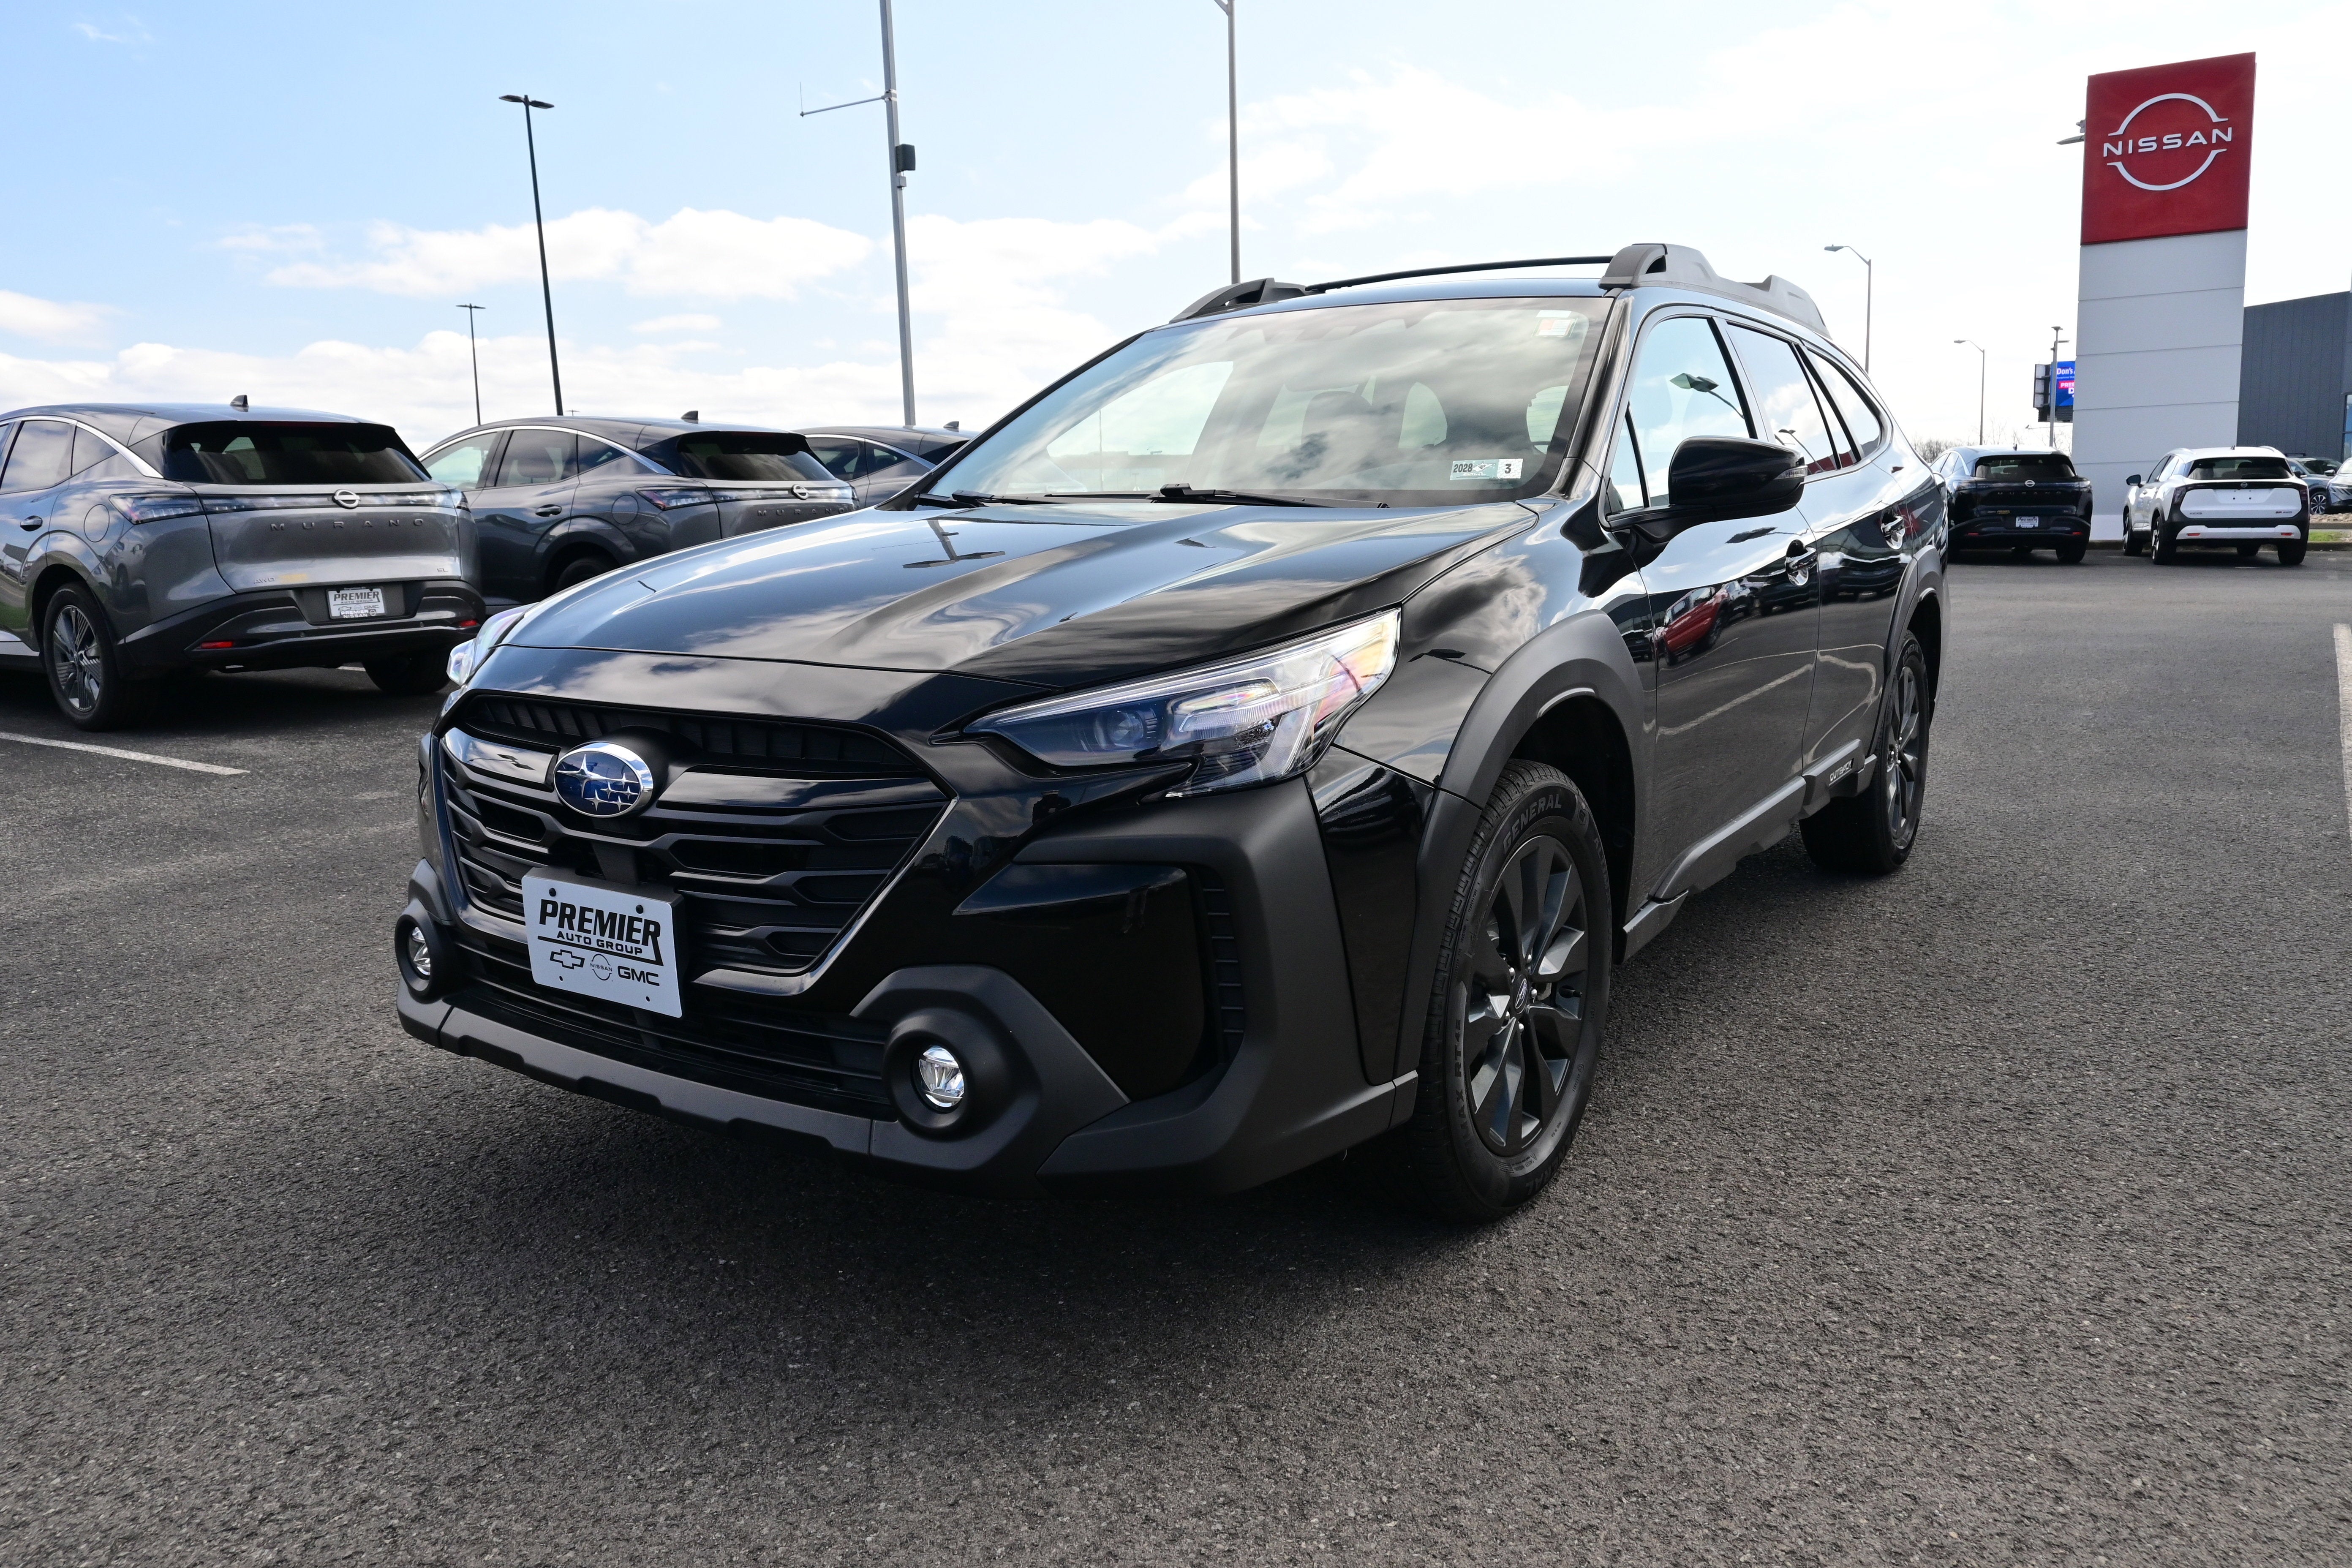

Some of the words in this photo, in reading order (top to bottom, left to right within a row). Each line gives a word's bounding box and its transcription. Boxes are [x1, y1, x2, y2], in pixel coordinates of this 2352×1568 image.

[2104, 127, 2232, 157] NISSAN
[1453, 463, 1473, 473] 2028
[1505, 464, 1512, 474] 3
[757, 508, 844, 516] MURANO
[271, 518, 424, 531] MURANO
[334, 591, 380, 602] PREMIER
[1503, 794, 1562, 855] GENERAL
[539, 899, 661, 947] PREMIER
[557, 931, 592, 945] AUTO
[596, 939, 642, 955] GROUP
[590, 963, 612, 972] NISSAN
[618, 966, 660, 986] GMC
